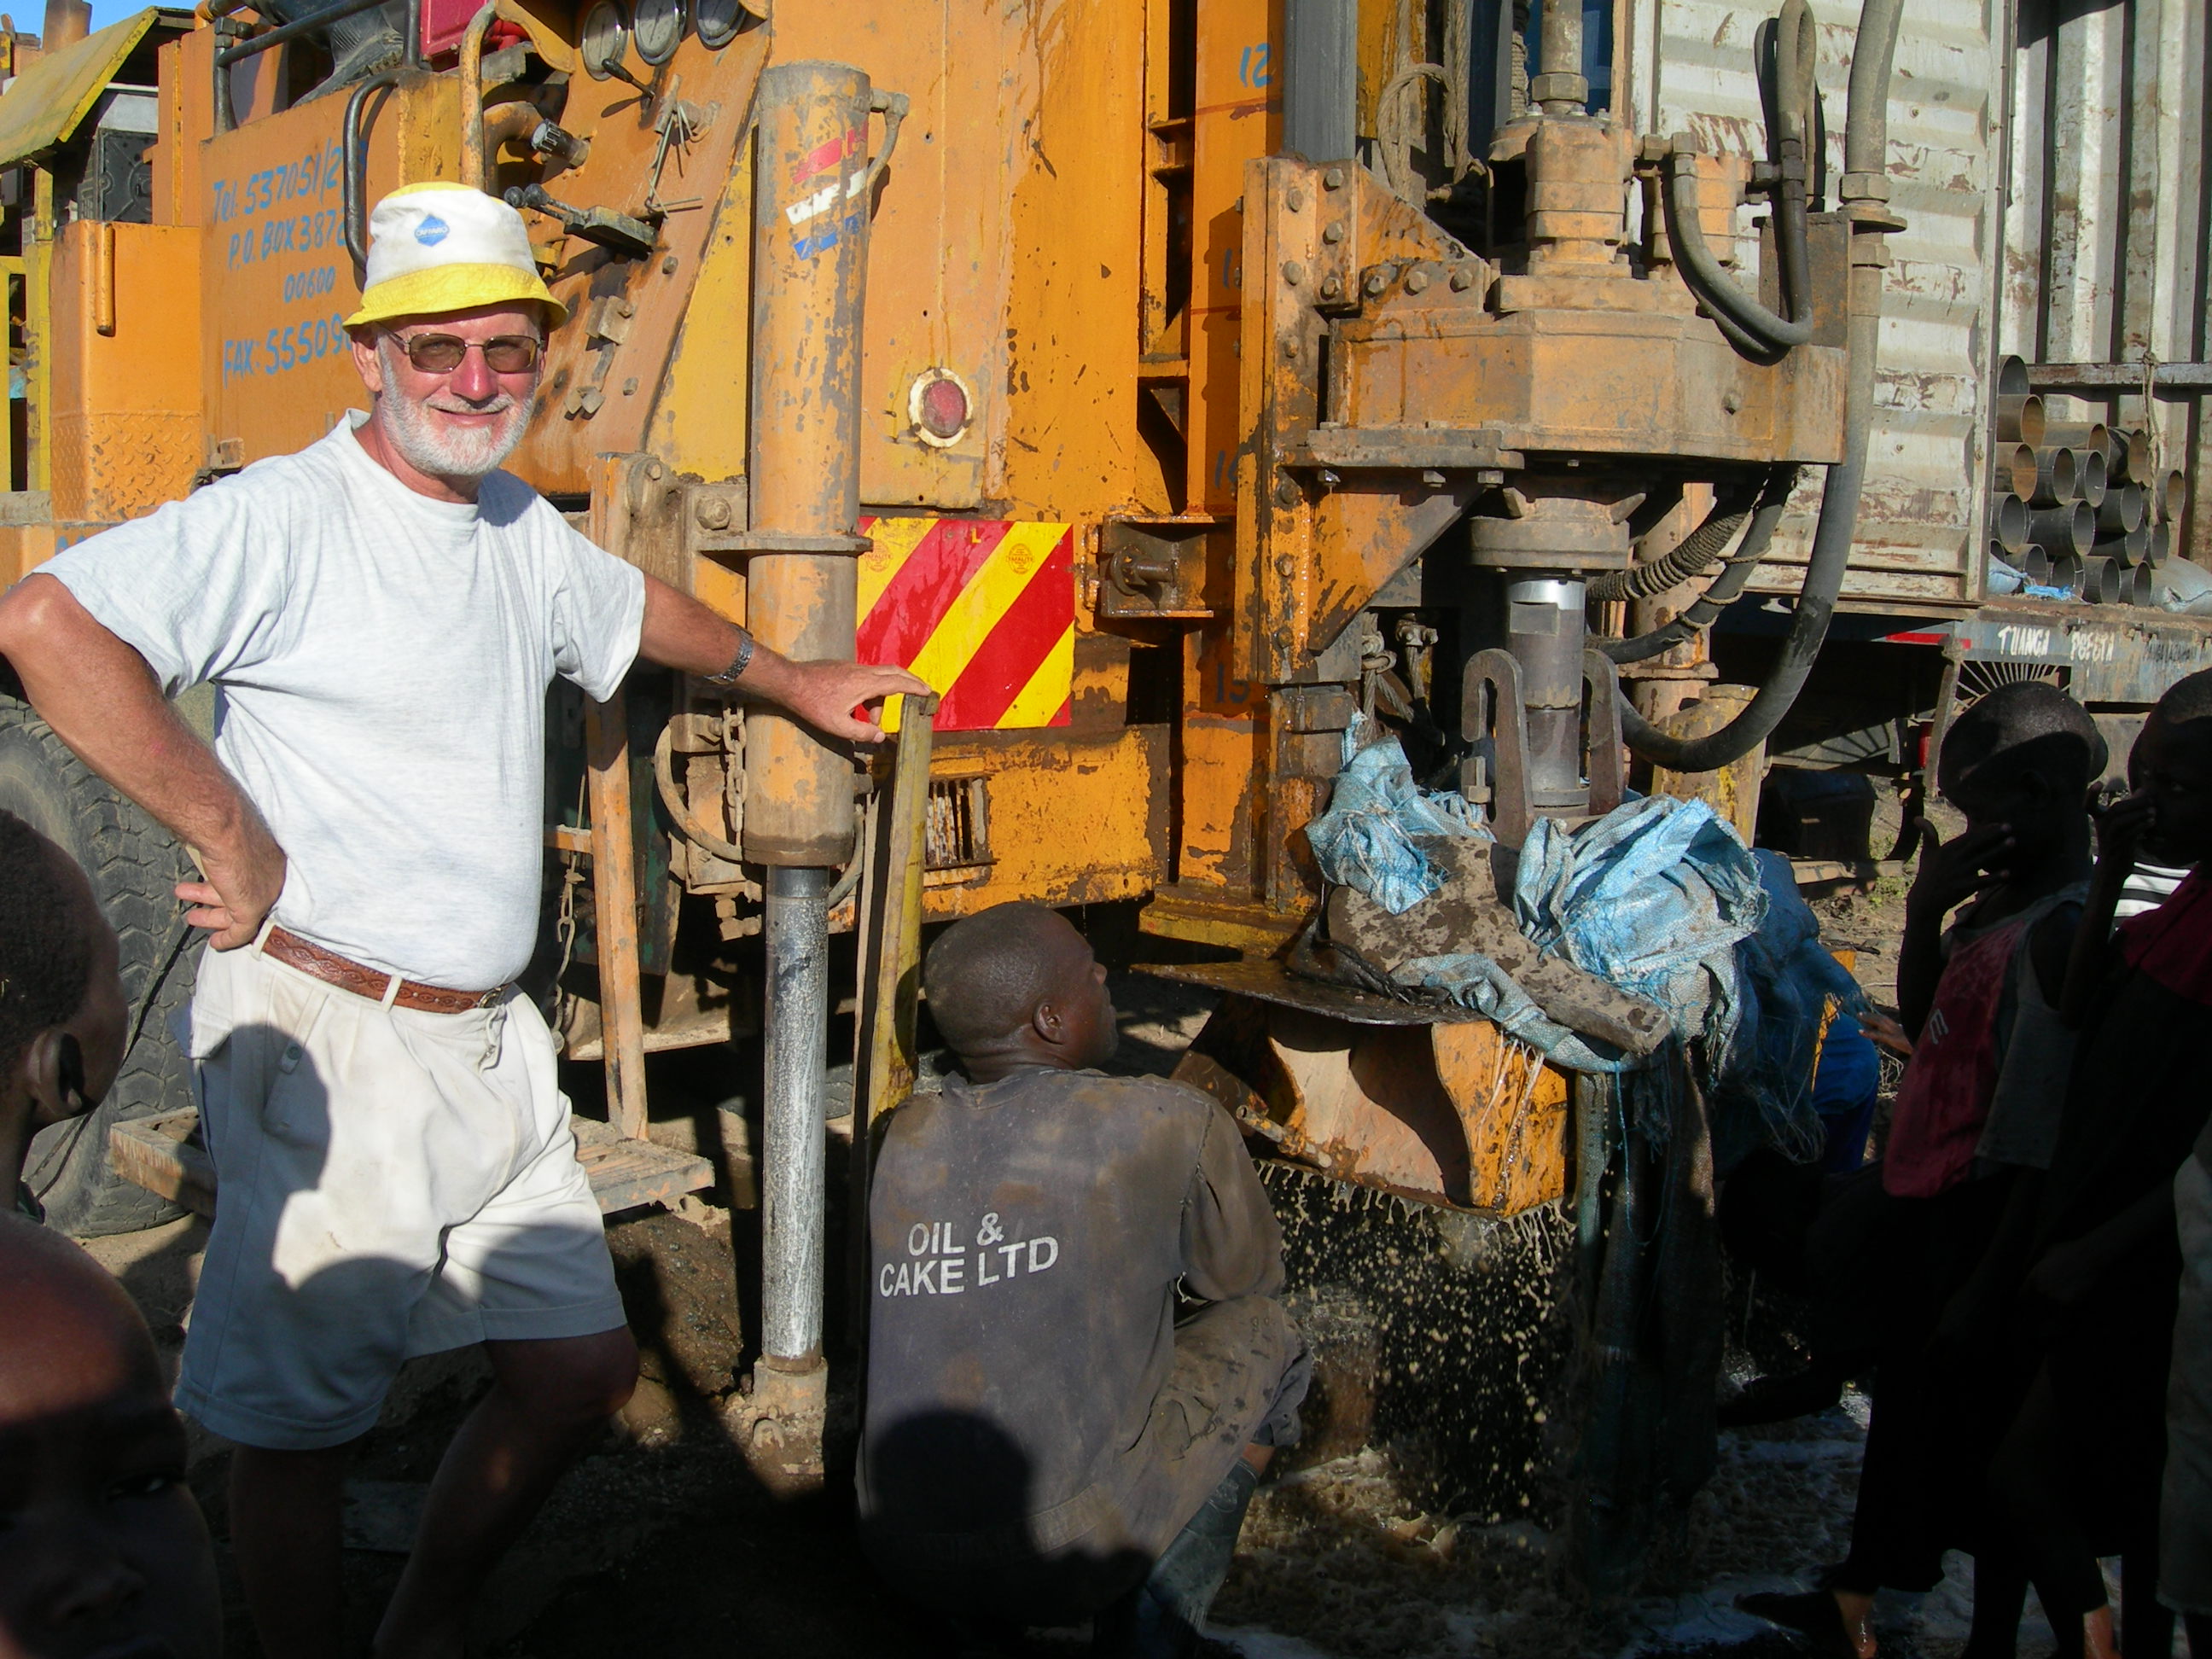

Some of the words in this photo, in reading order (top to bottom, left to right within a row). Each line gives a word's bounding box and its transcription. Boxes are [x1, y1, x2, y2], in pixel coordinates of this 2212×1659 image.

[1239, 43, 1272, 88] 12
[261, 218, 296, 260] BOX
[283, 265, 335, 303] 00600
[223, 339, 260, 389] FAX:
[265, 312, 352, 375] 55509
[908, 1222, 965, 1256] OIL
[976, 1212, 1004, 1246] &
[880, 1258, 965, 1297] CAKE
[978, 1237, 1059, 1286] LTD
